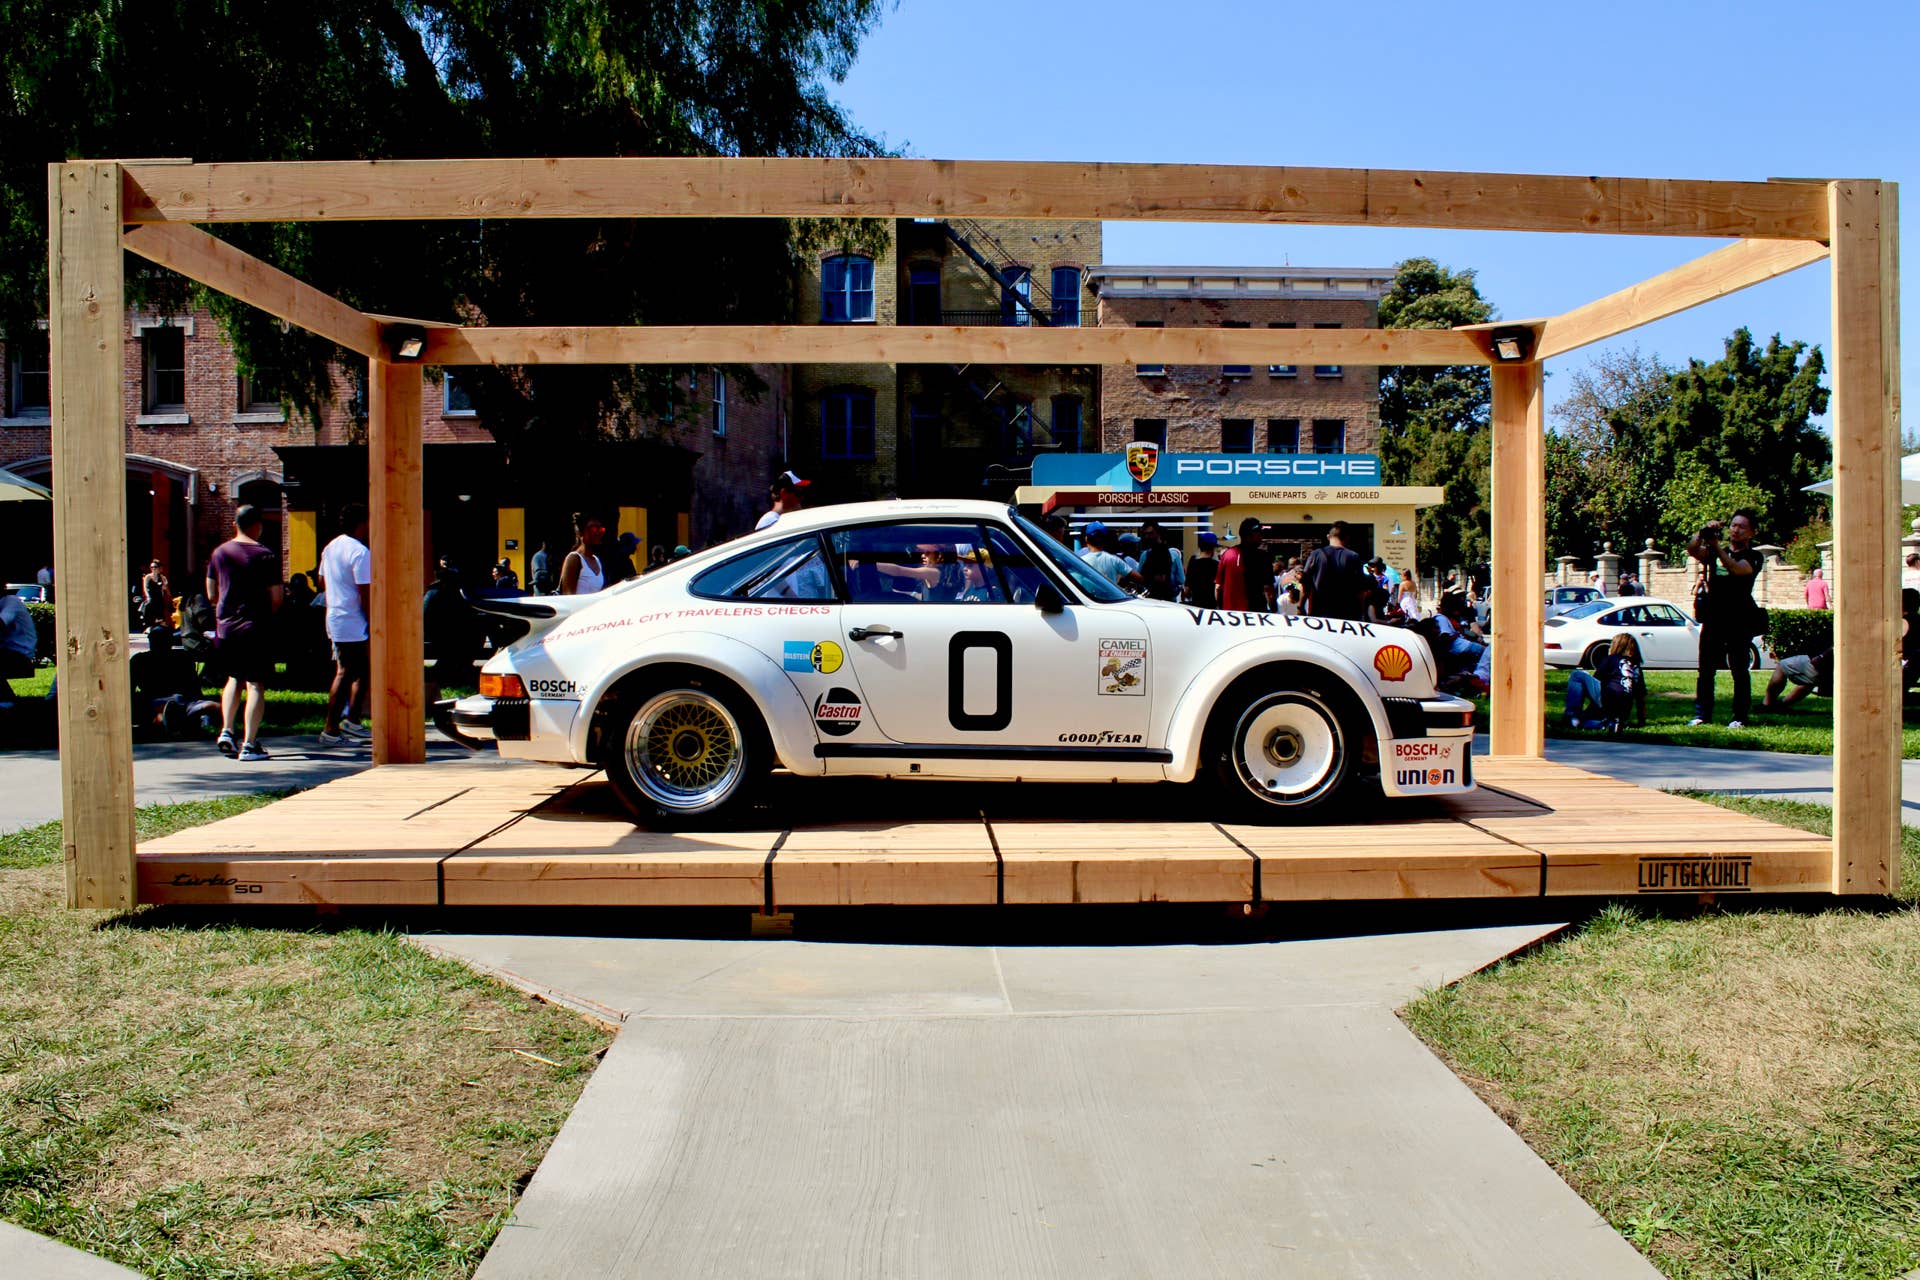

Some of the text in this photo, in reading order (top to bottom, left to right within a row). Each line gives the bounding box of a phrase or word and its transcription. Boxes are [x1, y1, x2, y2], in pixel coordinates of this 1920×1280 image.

[1177, 459, 1376, 475] PORSCHE
[1098, 493, 1189, 503] PORSCHE CLASSIC
[1248, 491, 1307, 499] GENUINE PARTS
[1336, 491, 1380, 499] AIR COOLED
[566, 618, 634, 637] NATIONAL
[639, 611, 673, 624] CITY
[677, 607, 763, 618] TRAVELERS
[767, 606, 831, 616] CHECKS
[1186, 608, 1377, 638] VASEK POLAK
[1101, 640, 1144, 650] CAMEL
[530, 680, 576, 692] BOSCH
[948, 630, 1013, 731] 0
[818, 704, 862, 718] Castrol
[1396, 744, 1438, 756] BOSCH
[1638, 856, 1752, 887] LUFTGEKÜHLT
[172, 874, 238, 886] turbo
[234, 885, 263, 894] 50
